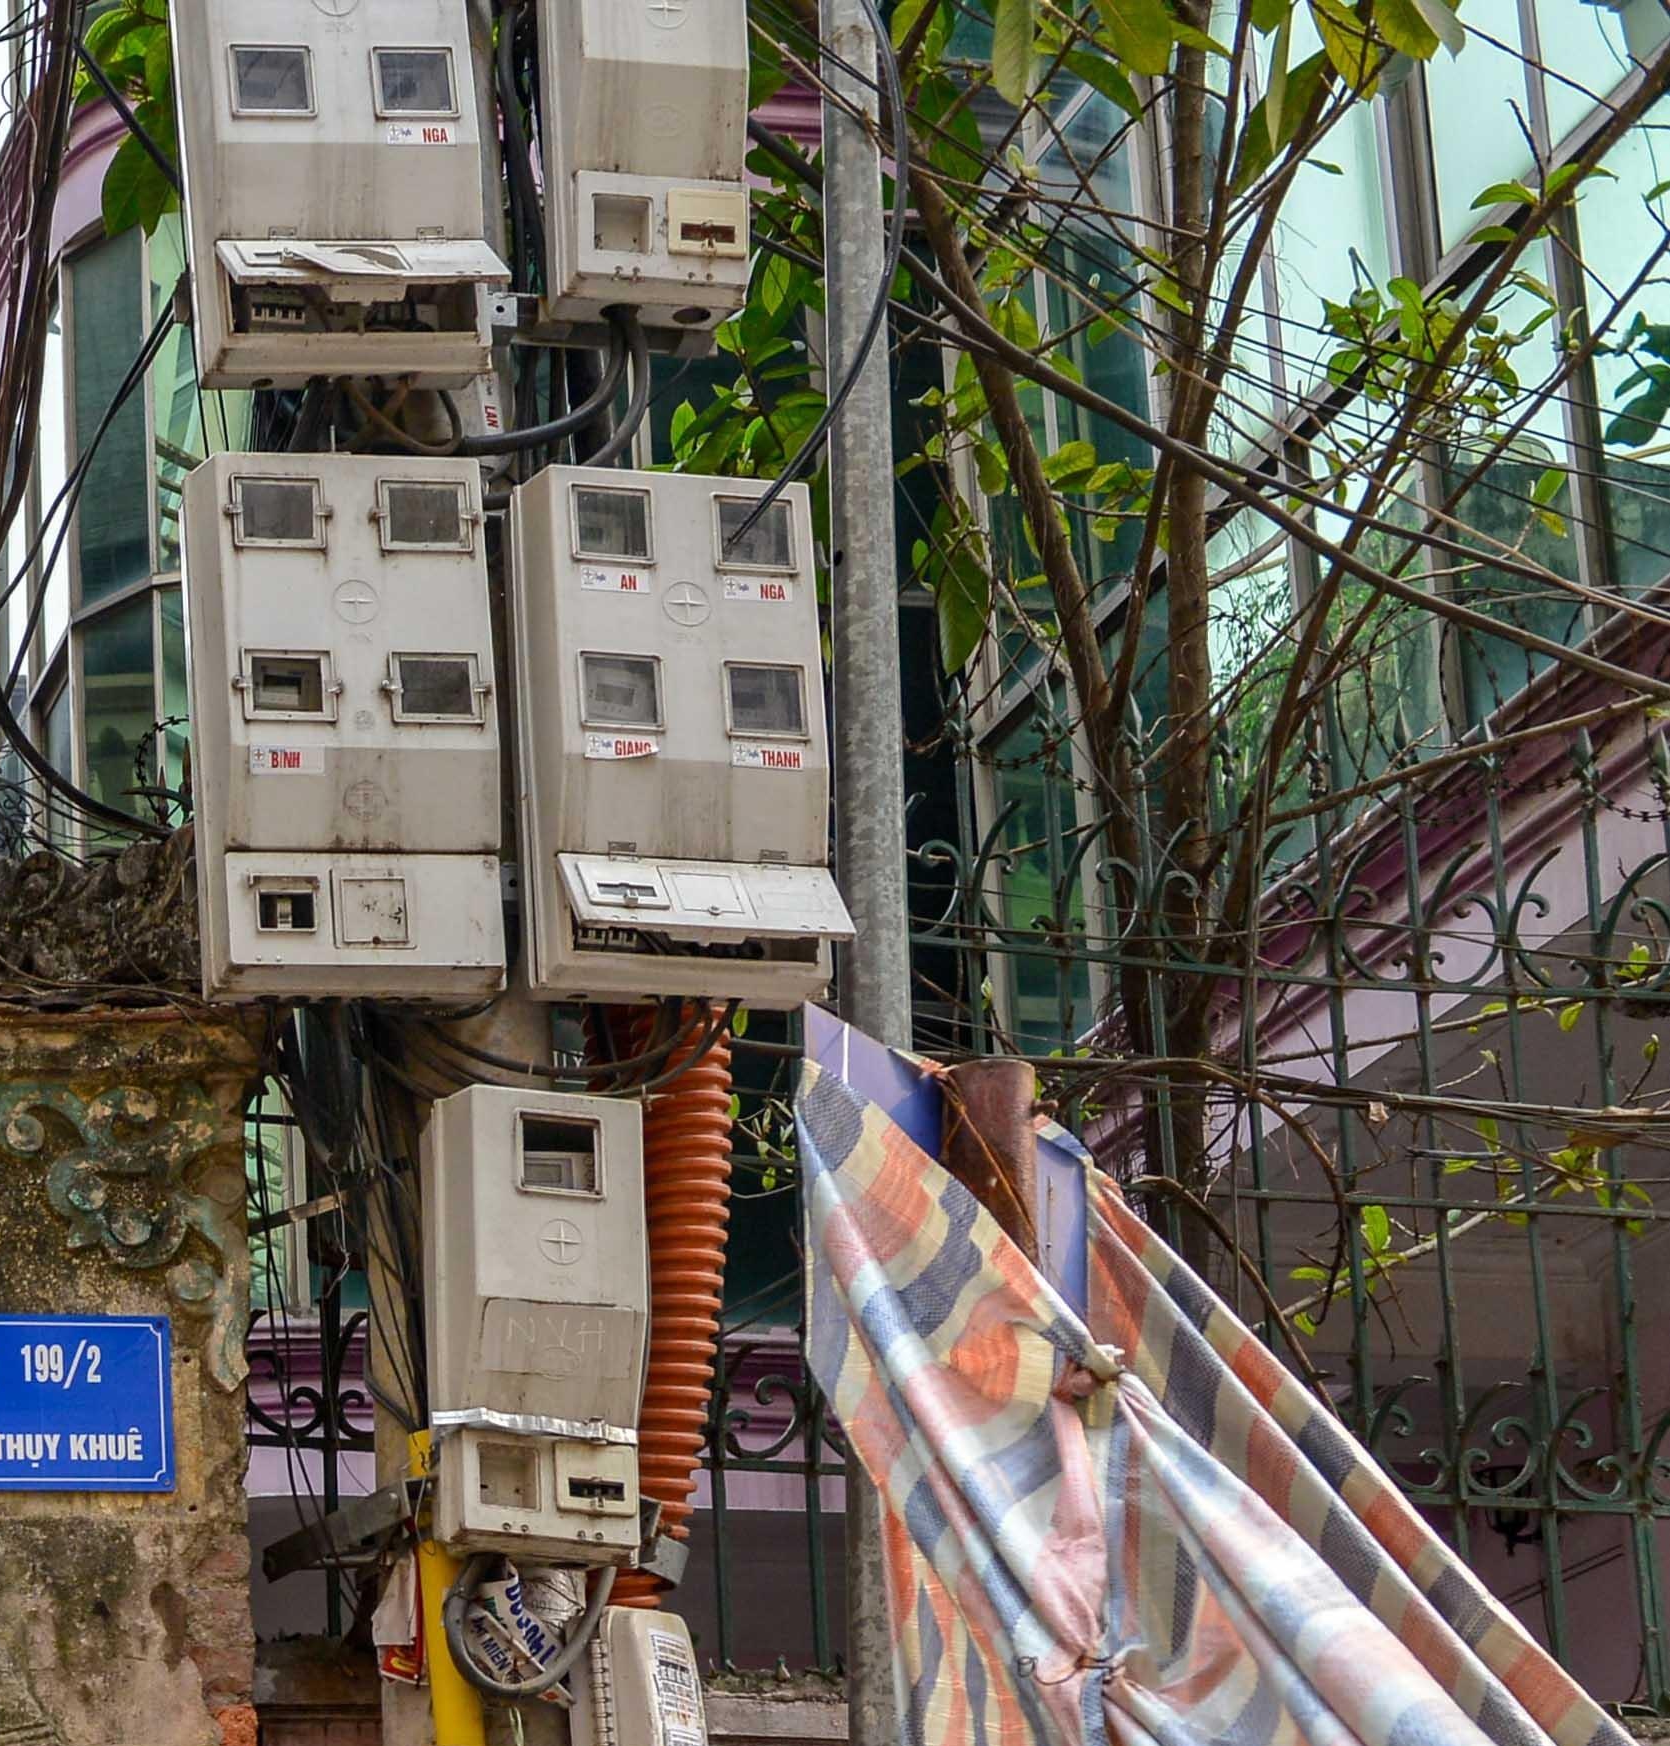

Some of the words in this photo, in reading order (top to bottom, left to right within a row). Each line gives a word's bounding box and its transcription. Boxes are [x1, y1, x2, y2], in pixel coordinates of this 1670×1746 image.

[422, 127, 448, 143] NGA
[484, 405, 499, 429] LAN
[620, 574, 637, 590] AN
[760, 583, 786, 600] NGA
[614, 740, 652, 756] GIANG
[760, 749, 801, 768] THANH
[20, 1338, 102, 1390] 199/2
[69, 1427, 144, 1461] KHUÊ
